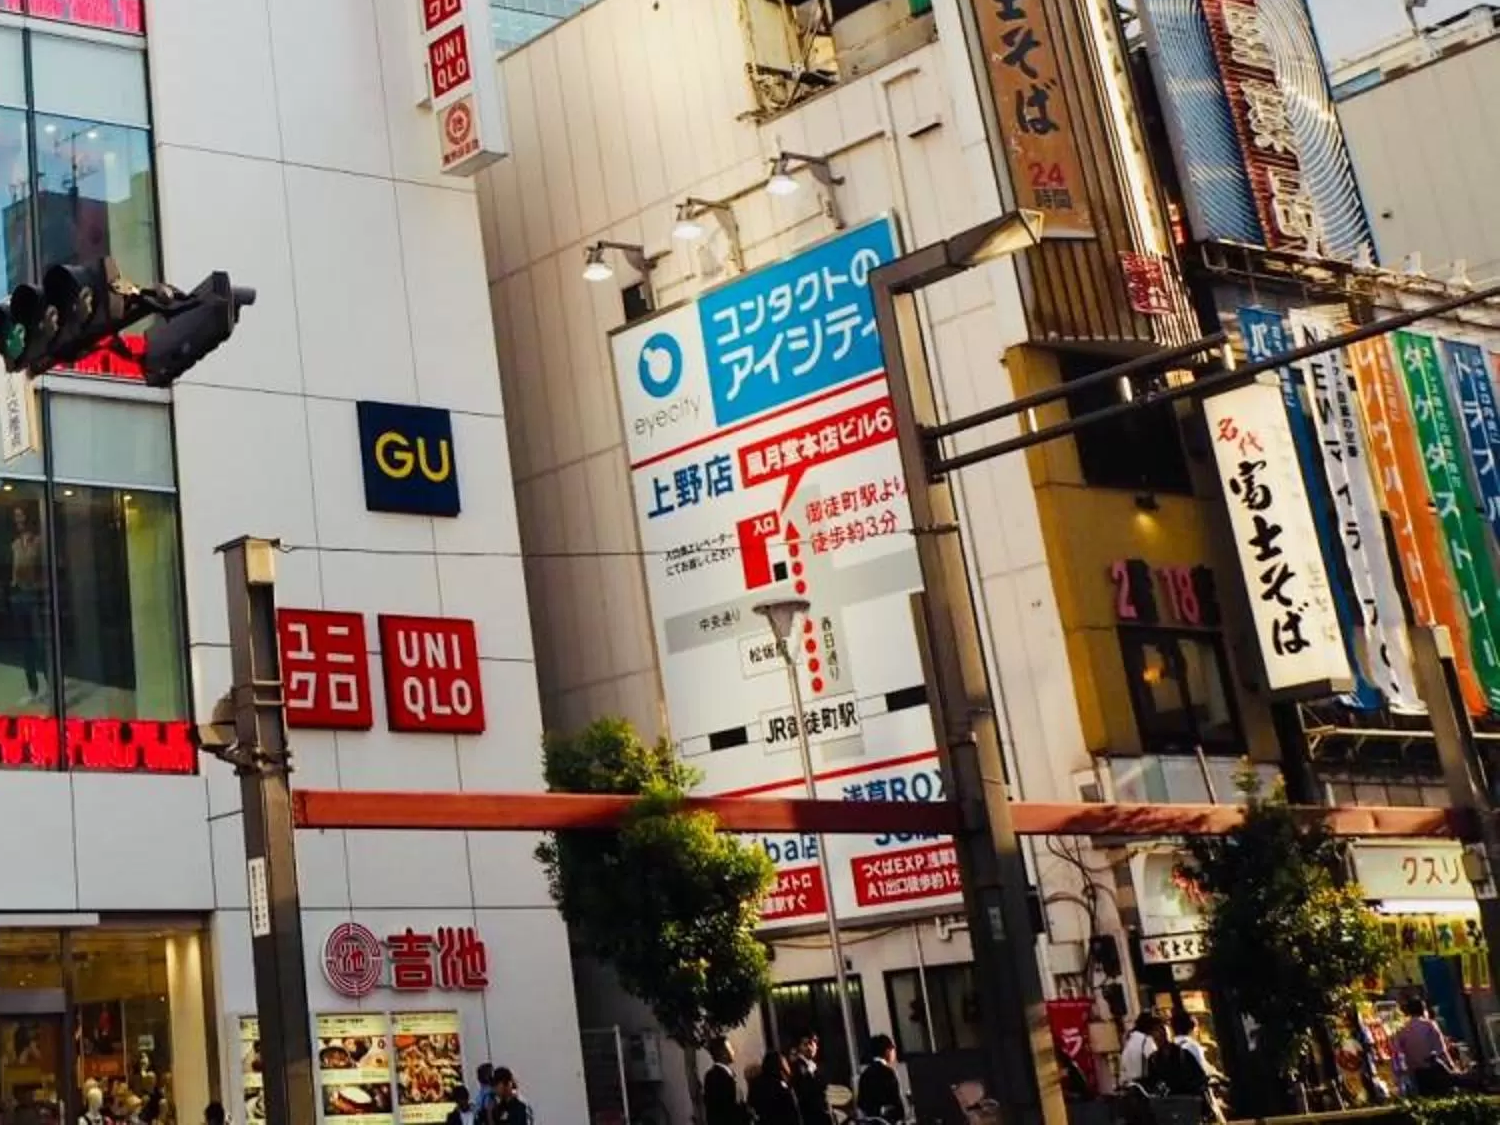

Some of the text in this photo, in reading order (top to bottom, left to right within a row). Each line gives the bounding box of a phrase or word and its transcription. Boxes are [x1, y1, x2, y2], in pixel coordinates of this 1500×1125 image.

[1029, 162, 1066, 188] 24
[712, 247, 880, 347] コンタクトの
[633, 395, 702, 440] eyecity
[375, 431, 451, 483] GU
[647, 453, 735, 519] 上野店
[752, 515, 777, 536] 入口
[810, 511, 899, 554] 徒歩約3分
[1228, 459, 1311, 657] 富士そば
[397, 629, 463, 670] UNI
[402, 677, 474, 722] QLO
[1401, 856, 1461, 886] クスリ
[386, 926, 490, 991] 吉池
